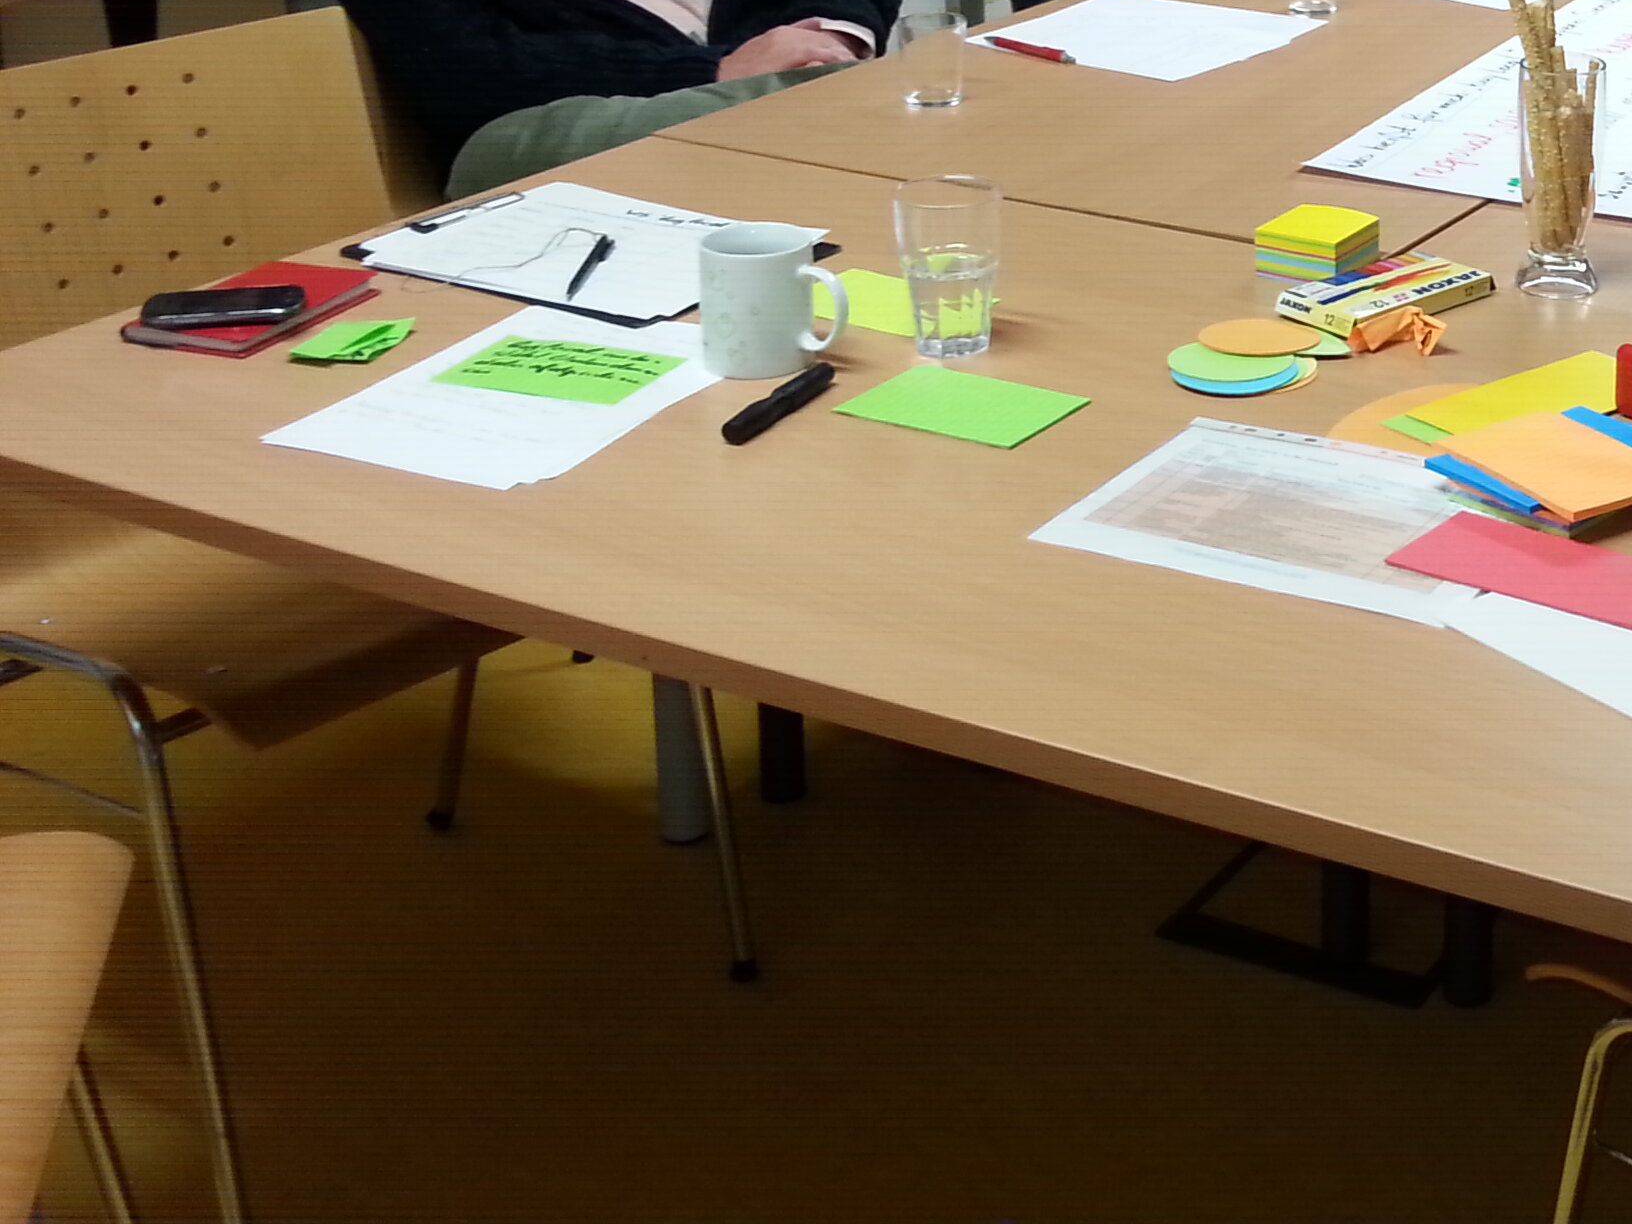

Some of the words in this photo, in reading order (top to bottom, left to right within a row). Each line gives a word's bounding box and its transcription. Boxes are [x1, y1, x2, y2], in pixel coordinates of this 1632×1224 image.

[1411, 270, 1481, 295] JAXON
[1280, 297, 1312, 314] JAXON
[1324, 313, 1336, 326] 12
